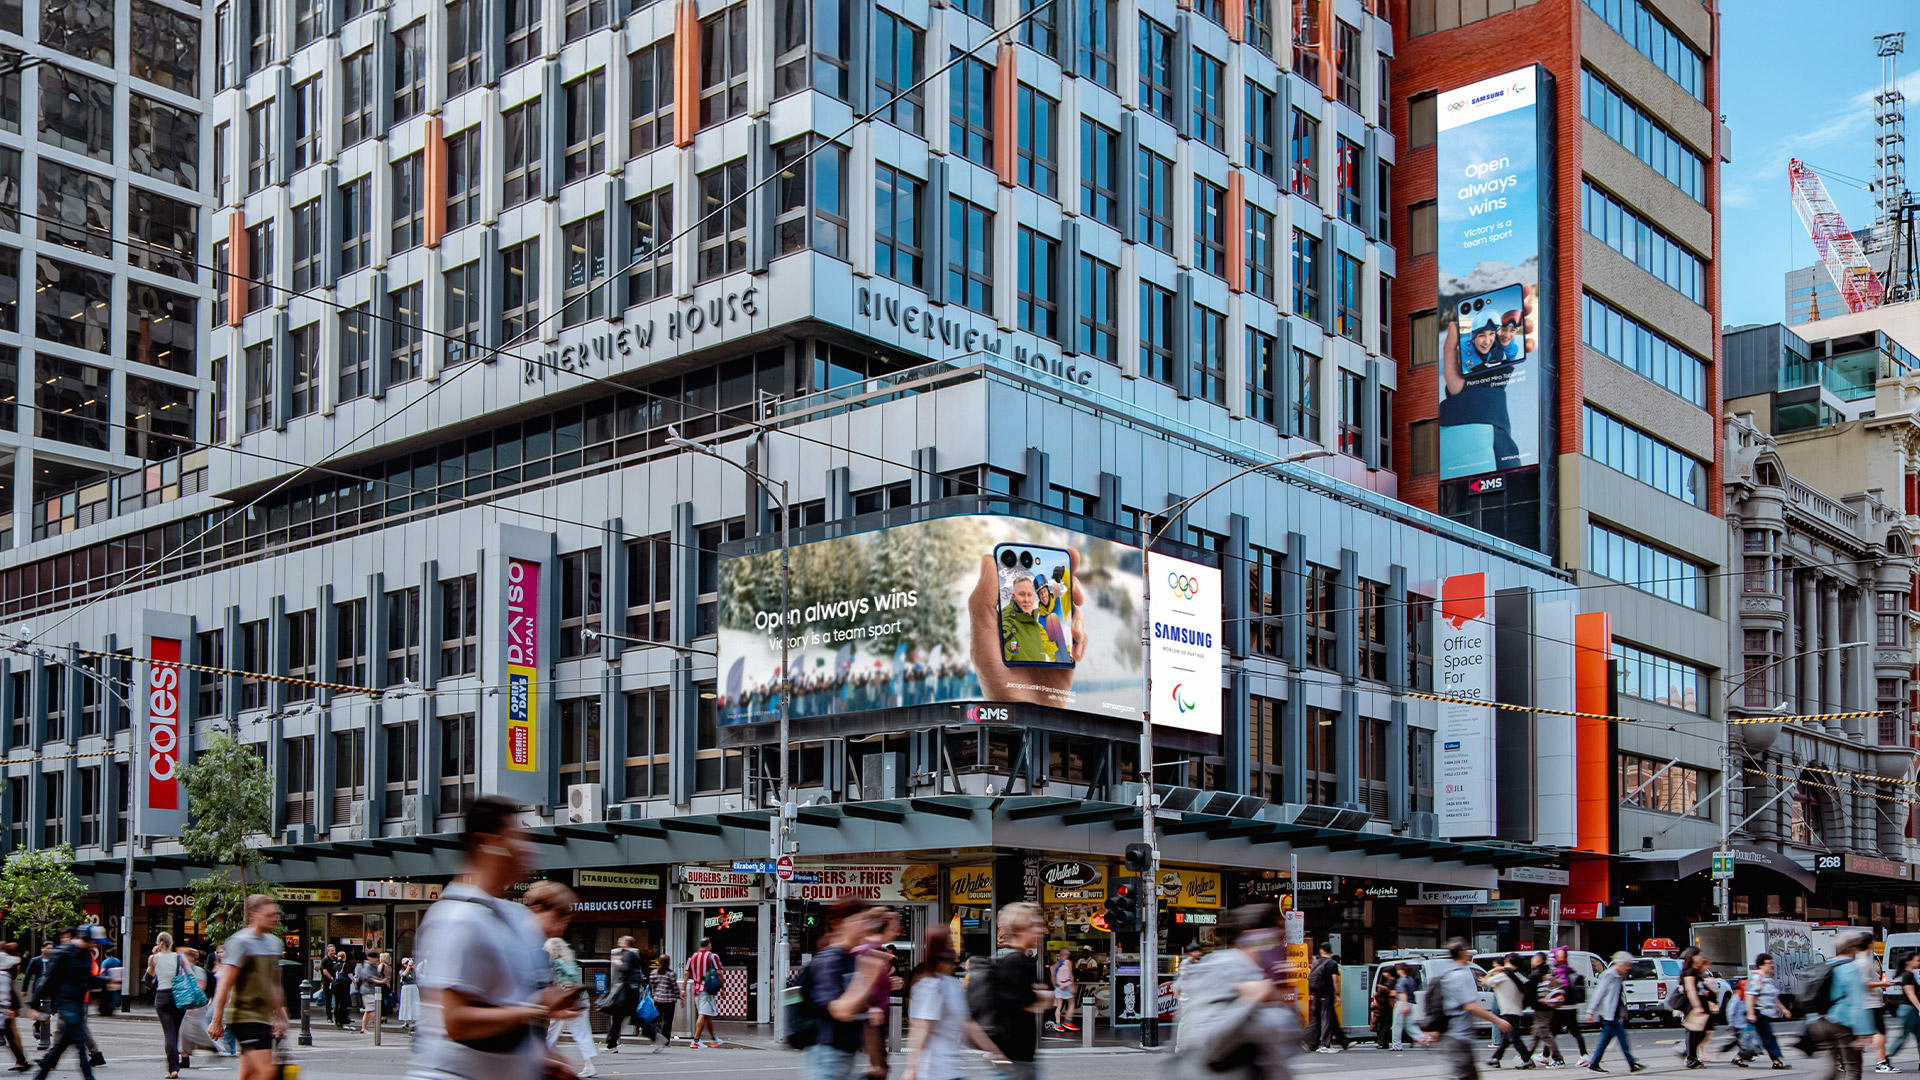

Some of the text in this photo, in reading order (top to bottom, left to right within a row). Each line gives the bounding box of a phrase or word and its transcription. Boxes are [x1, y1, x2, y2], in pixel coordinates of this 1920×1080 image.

[1471, 90, 1504, 105] SAMSUNG
[1465, 157, 1509, 179] Open
[1458, 174, 1517, 200] always
[1468, 196, 1507, 216] wins
[1464, 220, 1512, 238] Victory is a
[1464, 229, 1512, 249] team sport
[859, 286, 1001, 355] RIVERVIEW
[525, 287, 758, 385] RIVERVIEW HOUSE
[1480, 478, 1503, 490] QMS
[805, 597, 869, 622] always
[874, 588, 917, 611] wins
[507, 562, 524, 664] DAISO
[525, 617, 534, 665] JAPAN
[769, 620, 902, 650] Victory is a team sport
[1155, 622, 1212, 648] SAMSUNG
[1444, 636, 1481, 651] Office
[1162, 646, 1205, 659] WORLDWIDE PARTNER
[1444, 654, 1483, 670] Space
[1444, 672, 1465, 684] For
[511, 681, 519, 714] OPEN
[519, 678, 527, 718] 7 DAYS
[979, 707, 1008, 721] QMS
[1102, 702, 1136, 713] samsung.com
[149, 667, 177, 781] coles
[733, 862, 758, 870] Elizabeth
[1819, 856, 1841, 868] 268
[581, 874, 658, 886] STARBUCKS COFFEE
[688, 871, 748, 885] BURGERS FRIES
[794, 873, 812, 881] Flinders
[860, 871, 893, 884] FRIES
[1045, 863, 1080, 883] Walker's
[700, 886, 748, 899] COLD DRINKS
[802, 885, 881, 899] COLD DRINKS
[1186, 876, 1215, 897] Walker's
[1256, 883, 1271, 891] EAT
[1286, 881, 1332, 891] DOUGHNUTS
[164, 894, 196, 906] cole
[569, 900, 653, 911] STARBUCKS COFFEE
[1185, 913, 1193, 923] JAM
[1194, 914, 1217, 924] DOUGHNUTS
